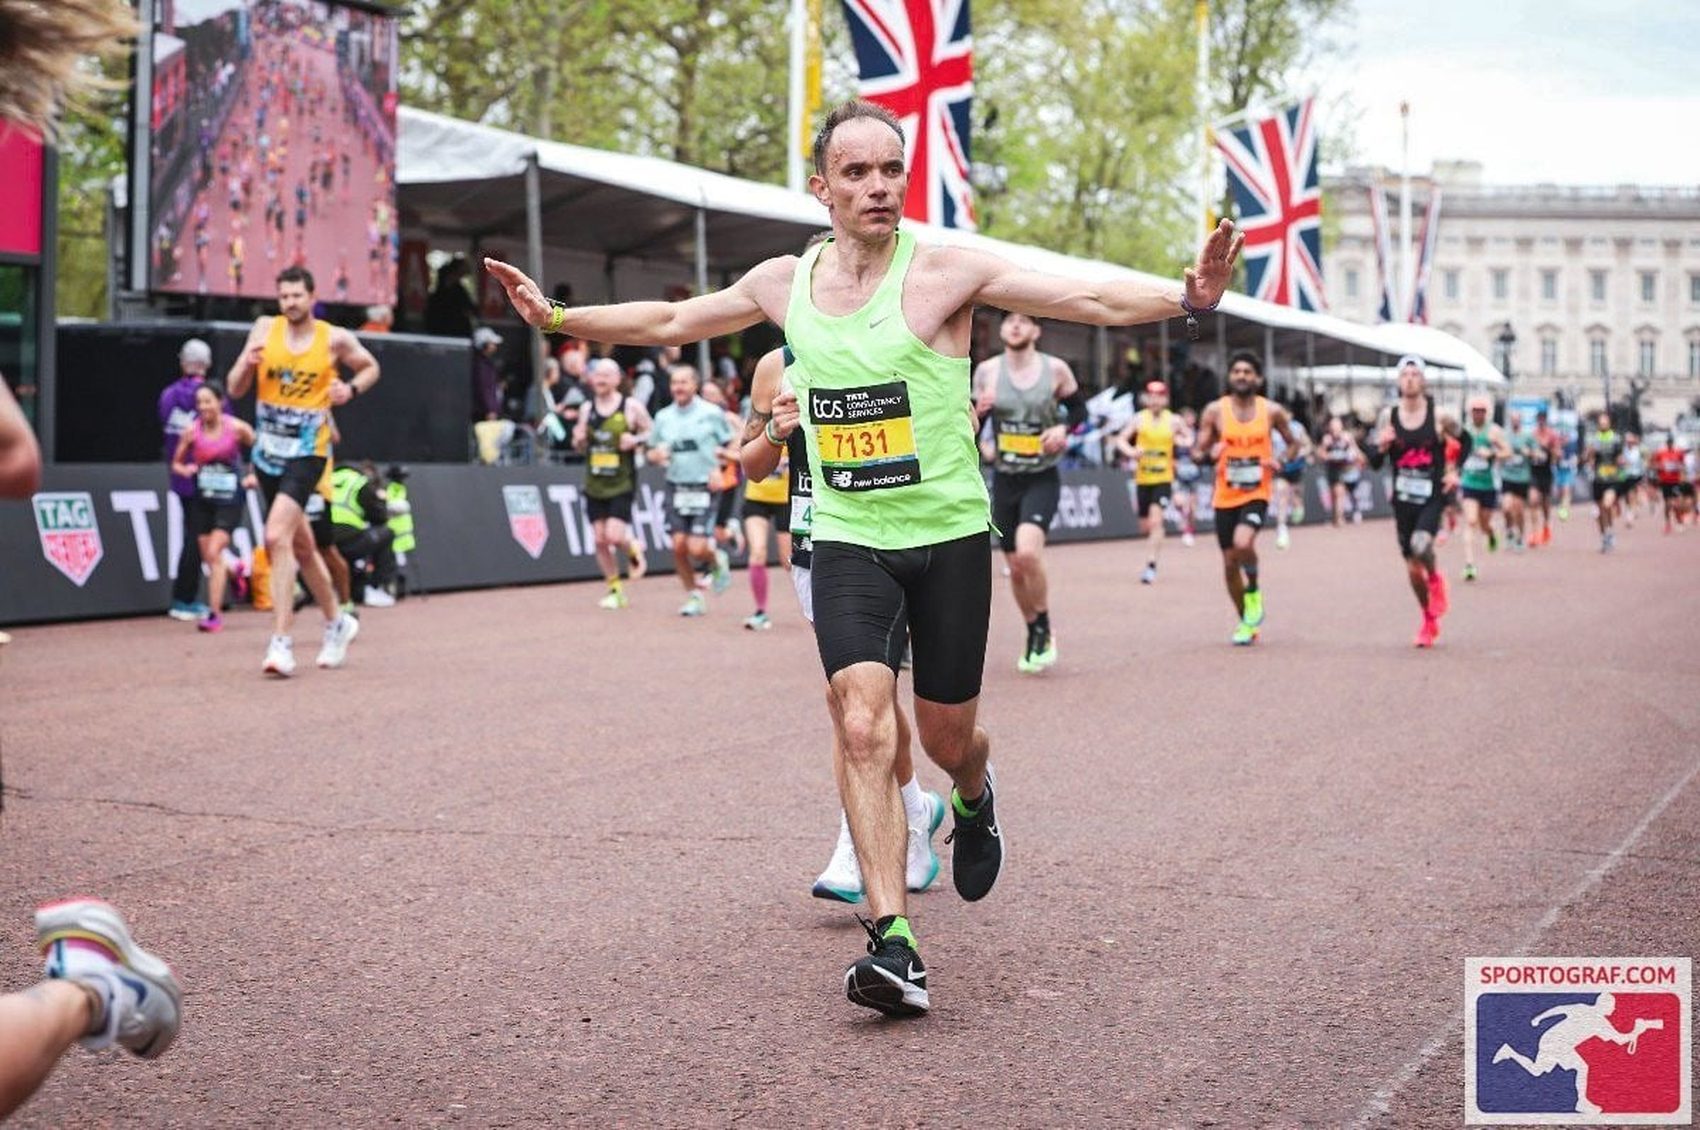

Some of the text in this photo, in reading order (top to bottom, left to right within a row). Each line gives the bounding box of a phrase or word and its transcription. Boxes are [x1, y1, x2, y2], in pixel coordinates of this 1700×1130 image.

[845, 391, 869, 401] TATA
[846, 396, 902, 410] CONSULTANCY
[813, 394, 844, 418] tcs
[848, 407, 884, 418] SERVICES
[832, 428, 888, 458] 7131
[798, 470, 812, 492] tc
[853, 474, 911, 488] new balance
[39, 500, 89, 528] TAG
